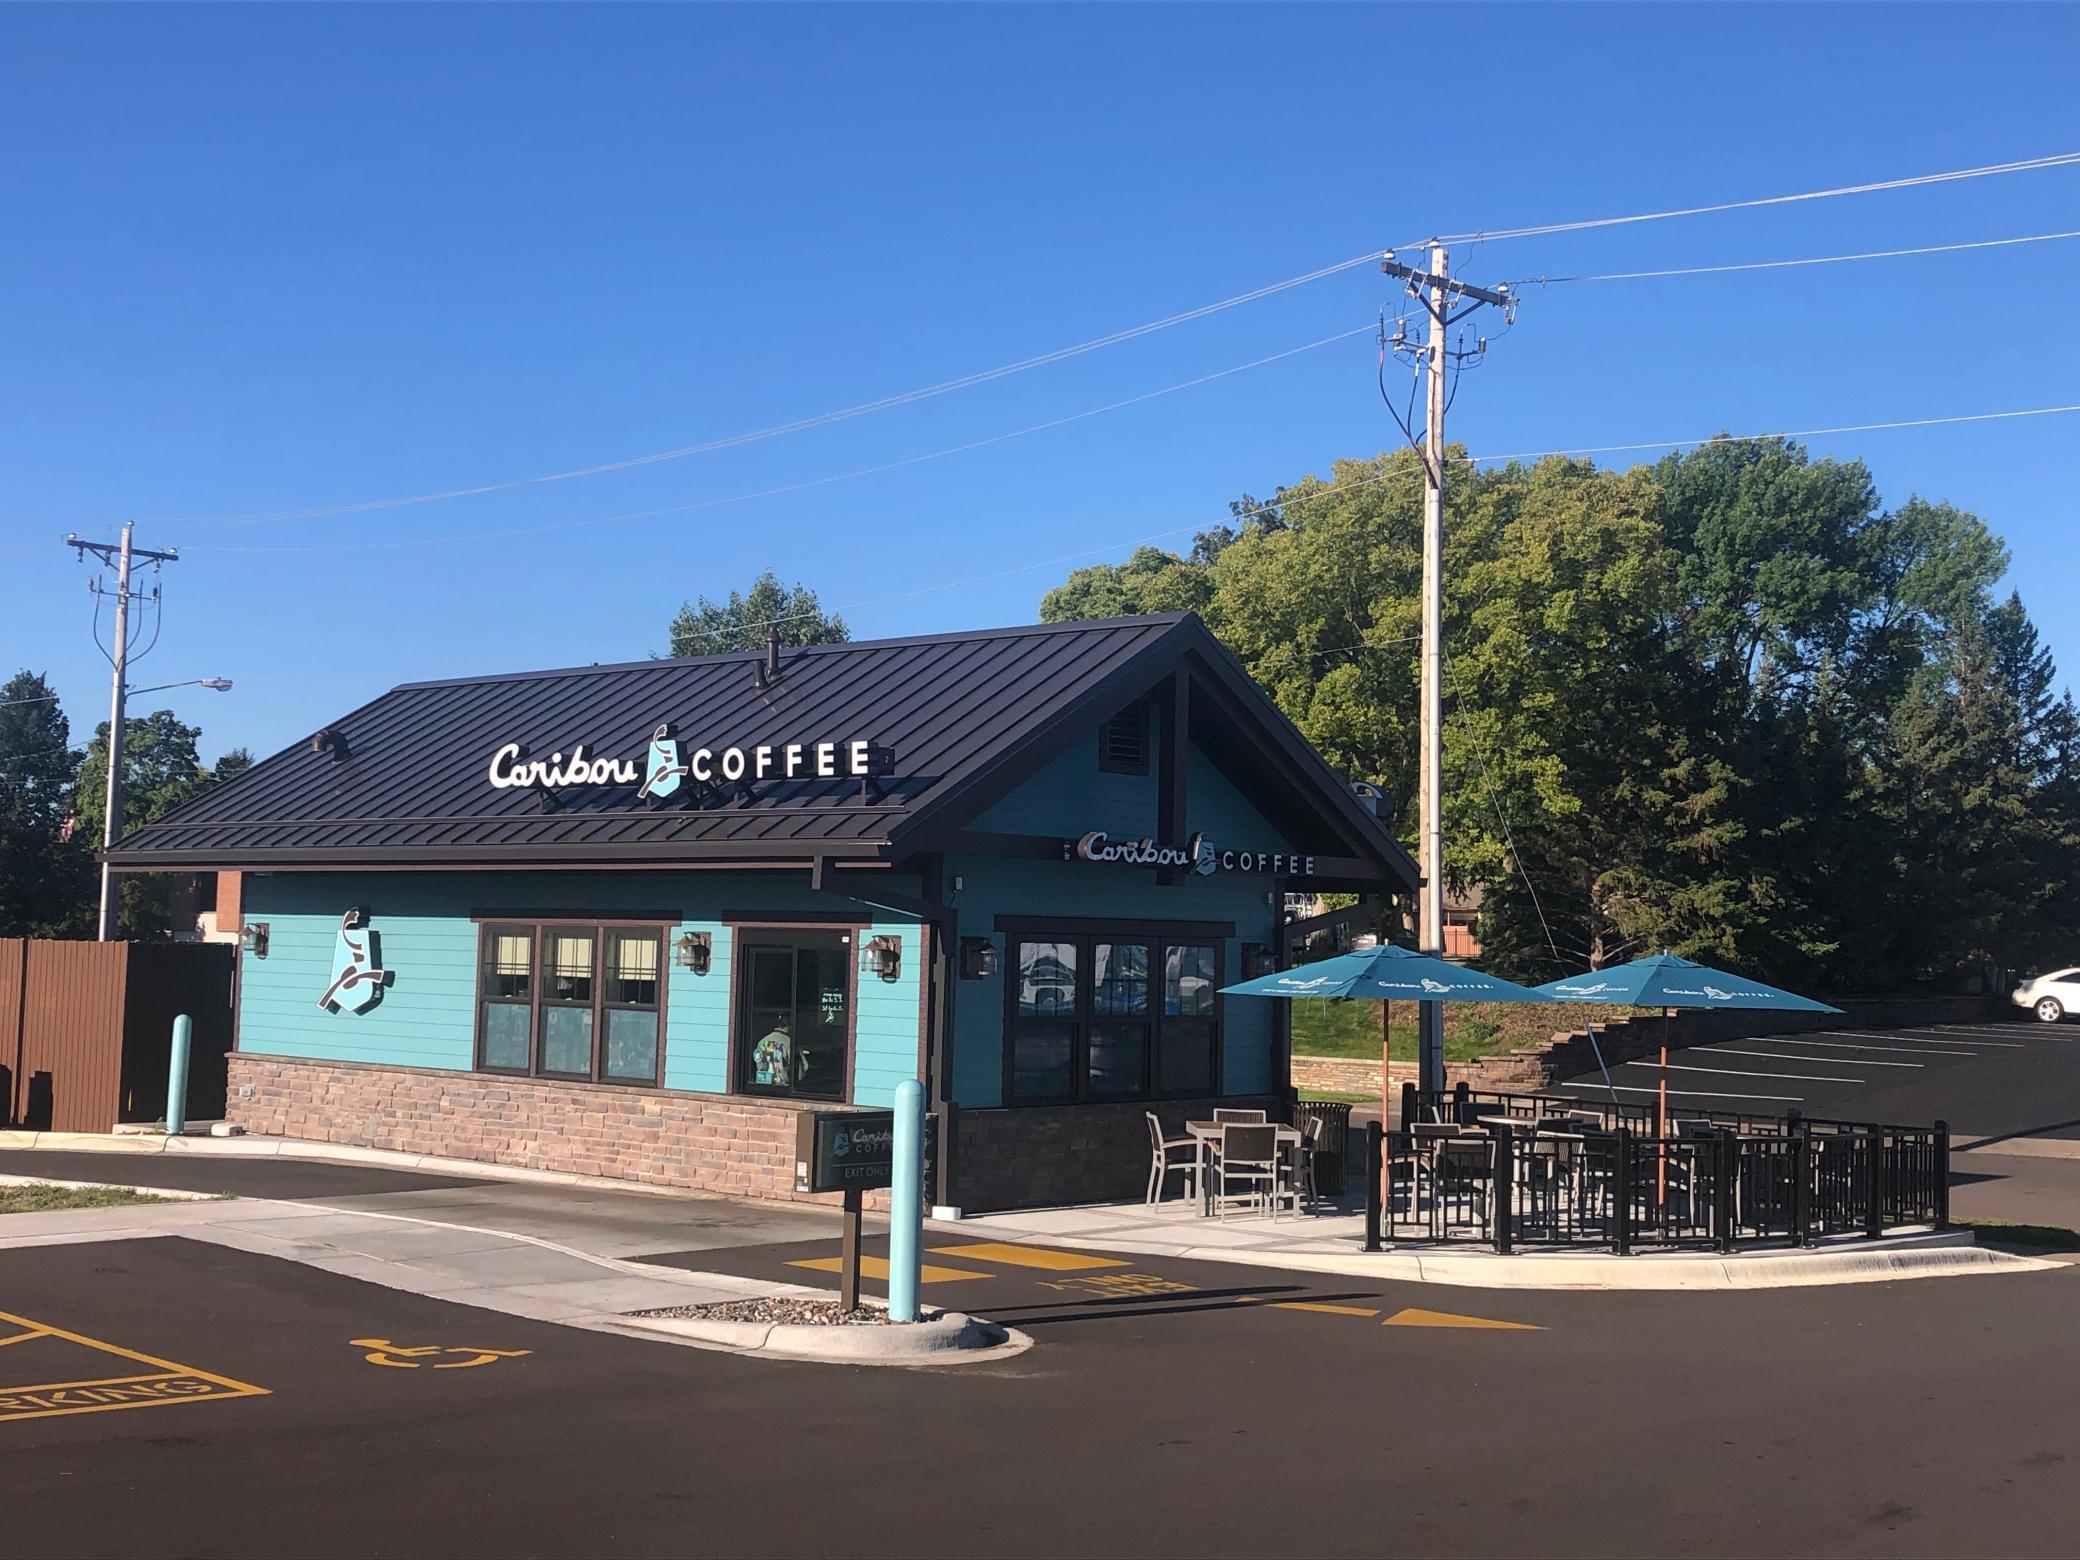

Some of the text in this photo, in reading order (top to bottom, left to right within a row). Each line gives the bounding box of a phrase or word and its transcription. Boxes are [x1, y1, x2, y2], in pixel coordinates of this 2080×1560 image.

[489, 740, 869, 788] Caribou COFFEE
[1080, 831, 1314, 875] Caribou COFFEE
[844, 1166, 890, 1178] EXIT ONLY
